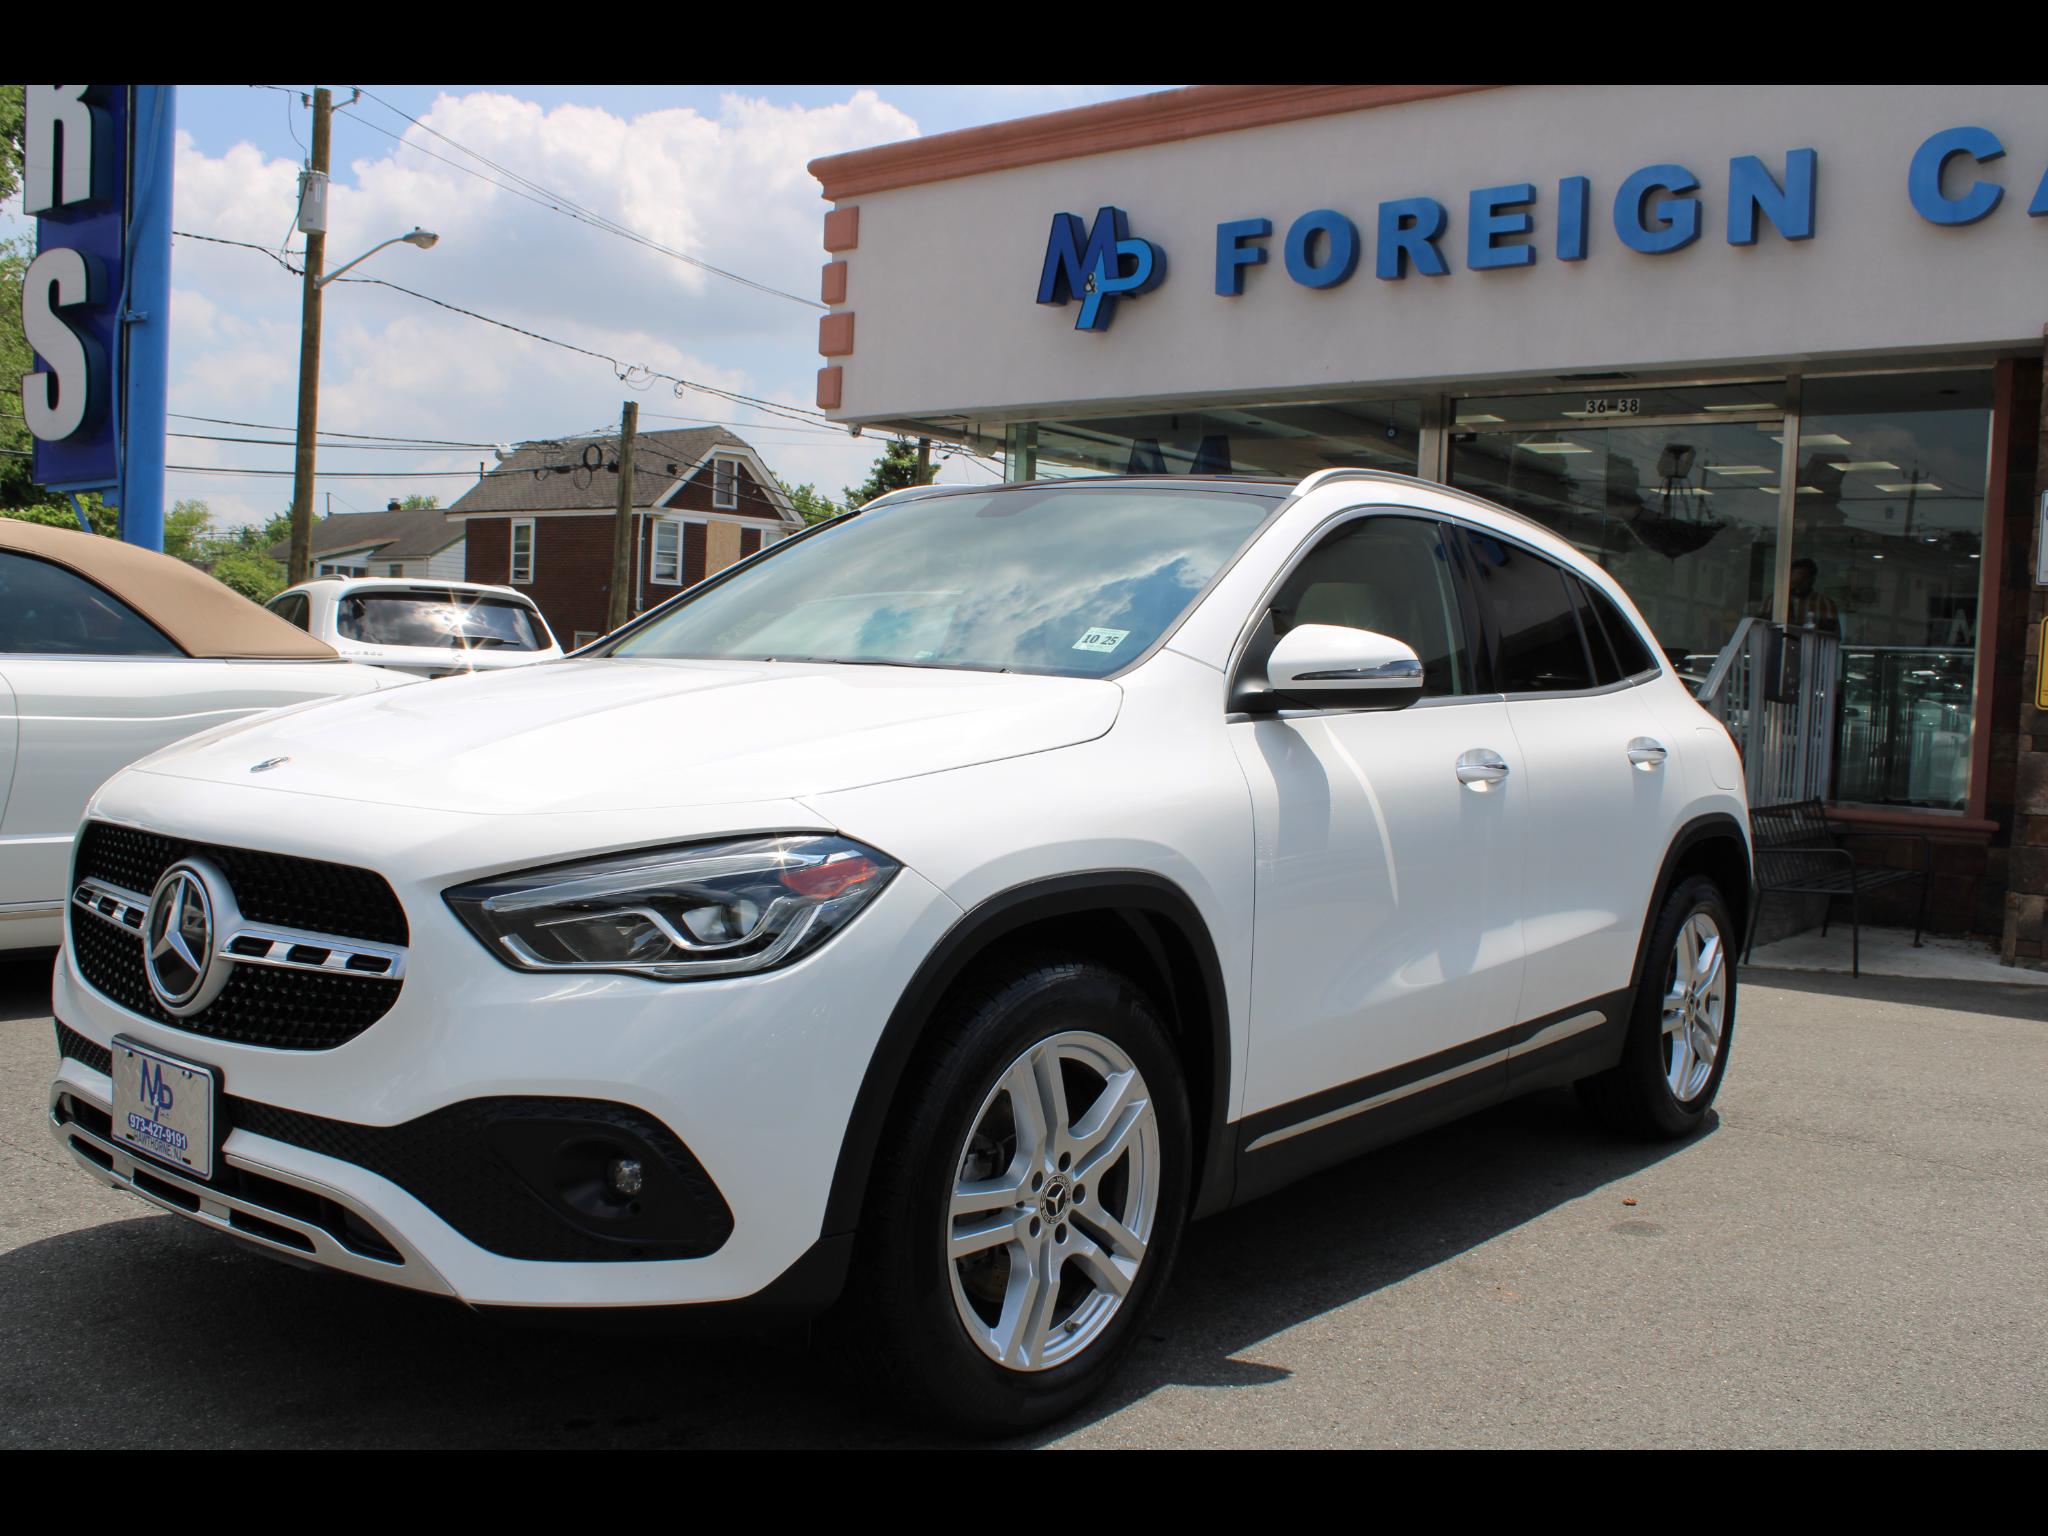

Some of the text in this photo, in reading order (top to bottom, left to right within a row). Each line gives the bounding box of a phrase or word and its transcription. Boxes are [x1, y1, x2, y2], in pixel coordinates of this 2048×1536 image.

[1215, 147, 1818, 298] FOREIGN
[1907, 126, 2048, 228] C
[1082, 634, 1119, 646] 10 25
[129, 1113, 187, 1150] 973-427-9191
